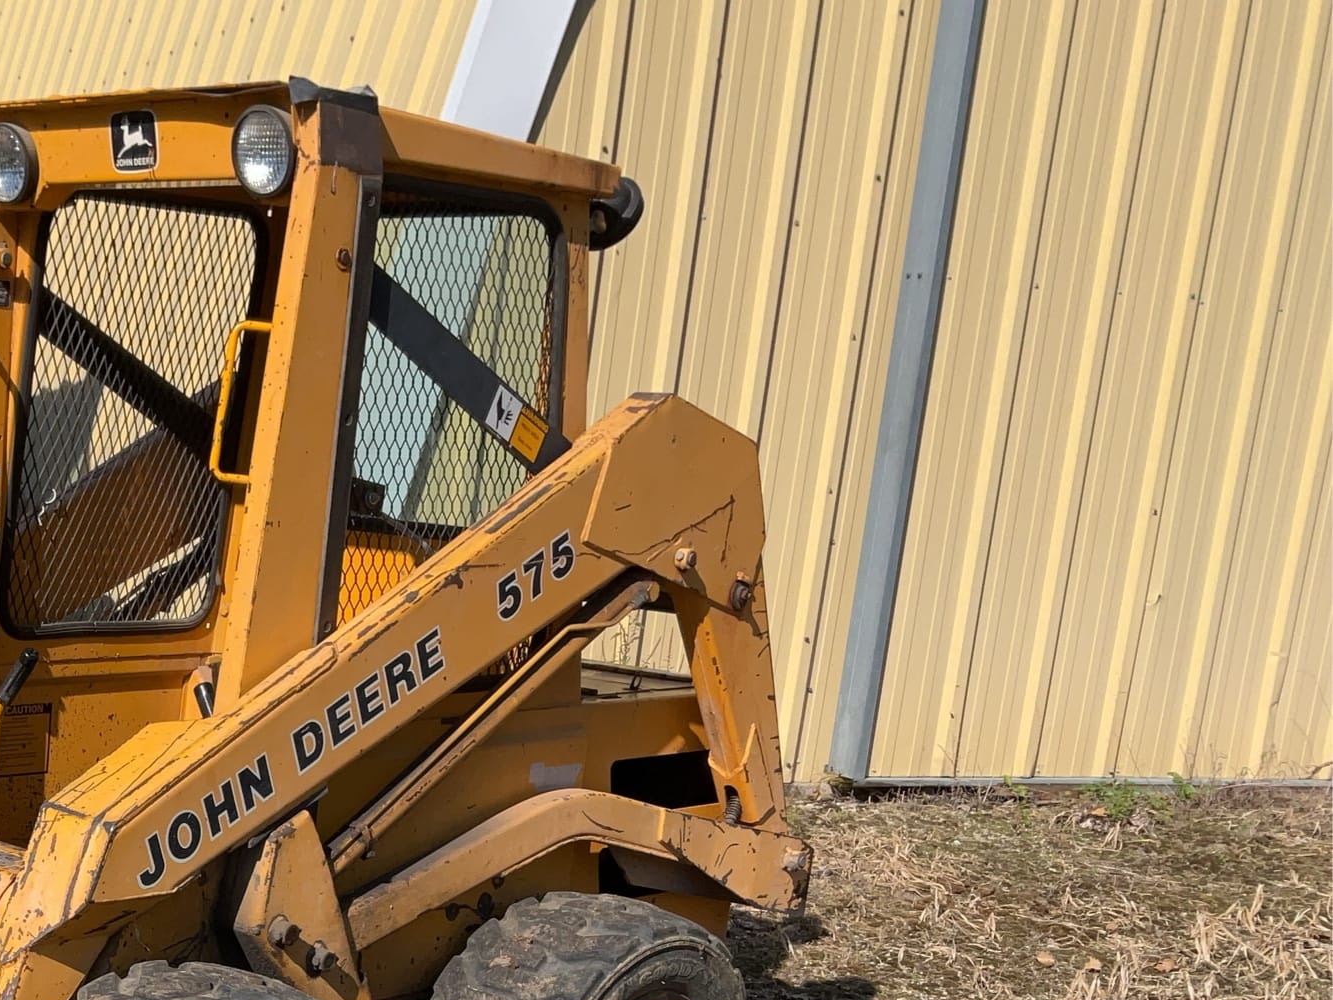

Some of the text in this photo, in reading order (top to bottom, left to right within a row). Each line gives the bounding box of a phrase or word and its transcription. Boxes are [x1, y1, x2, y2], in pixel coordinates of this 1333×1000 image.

[116, 156, 154, 167] JOHN DEERE
[6, 704, 44, 714] CAUTION
[137, 529, 576, 888] JOHN DEERE 575
